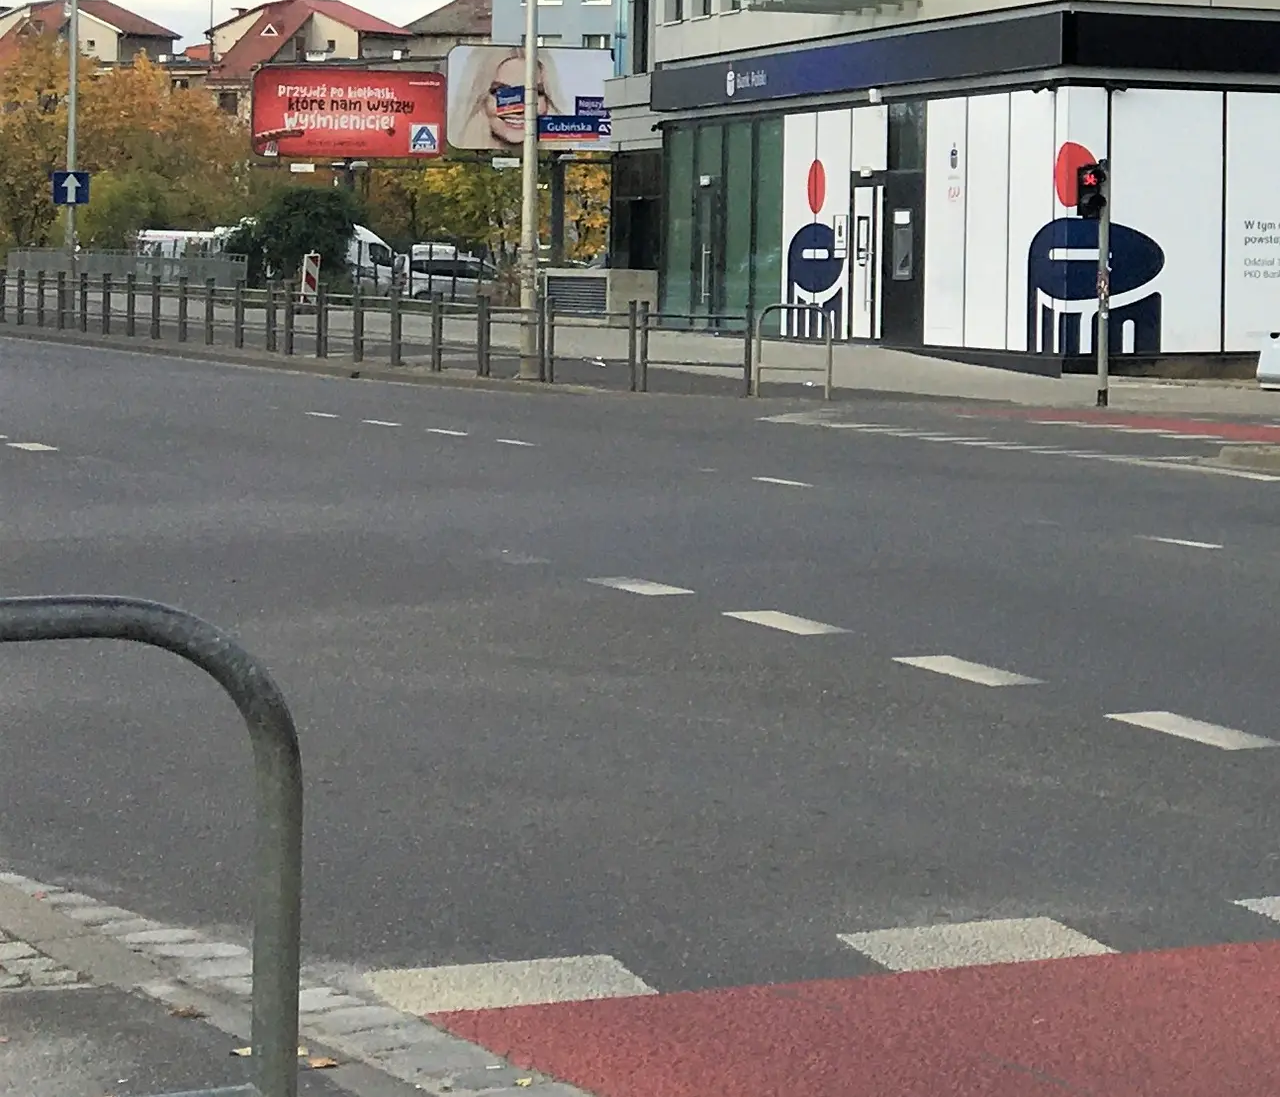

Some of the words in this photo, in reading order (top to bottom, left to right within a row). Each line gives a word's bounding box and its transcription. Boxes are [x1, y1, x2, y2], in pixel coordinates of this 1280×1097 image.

[330, 99, 362, 112] nam
[547, 122, 593, 133] Gubińska
[1244, 220, 1255, 230] W
[1257, 221, 1276, 232] tym
